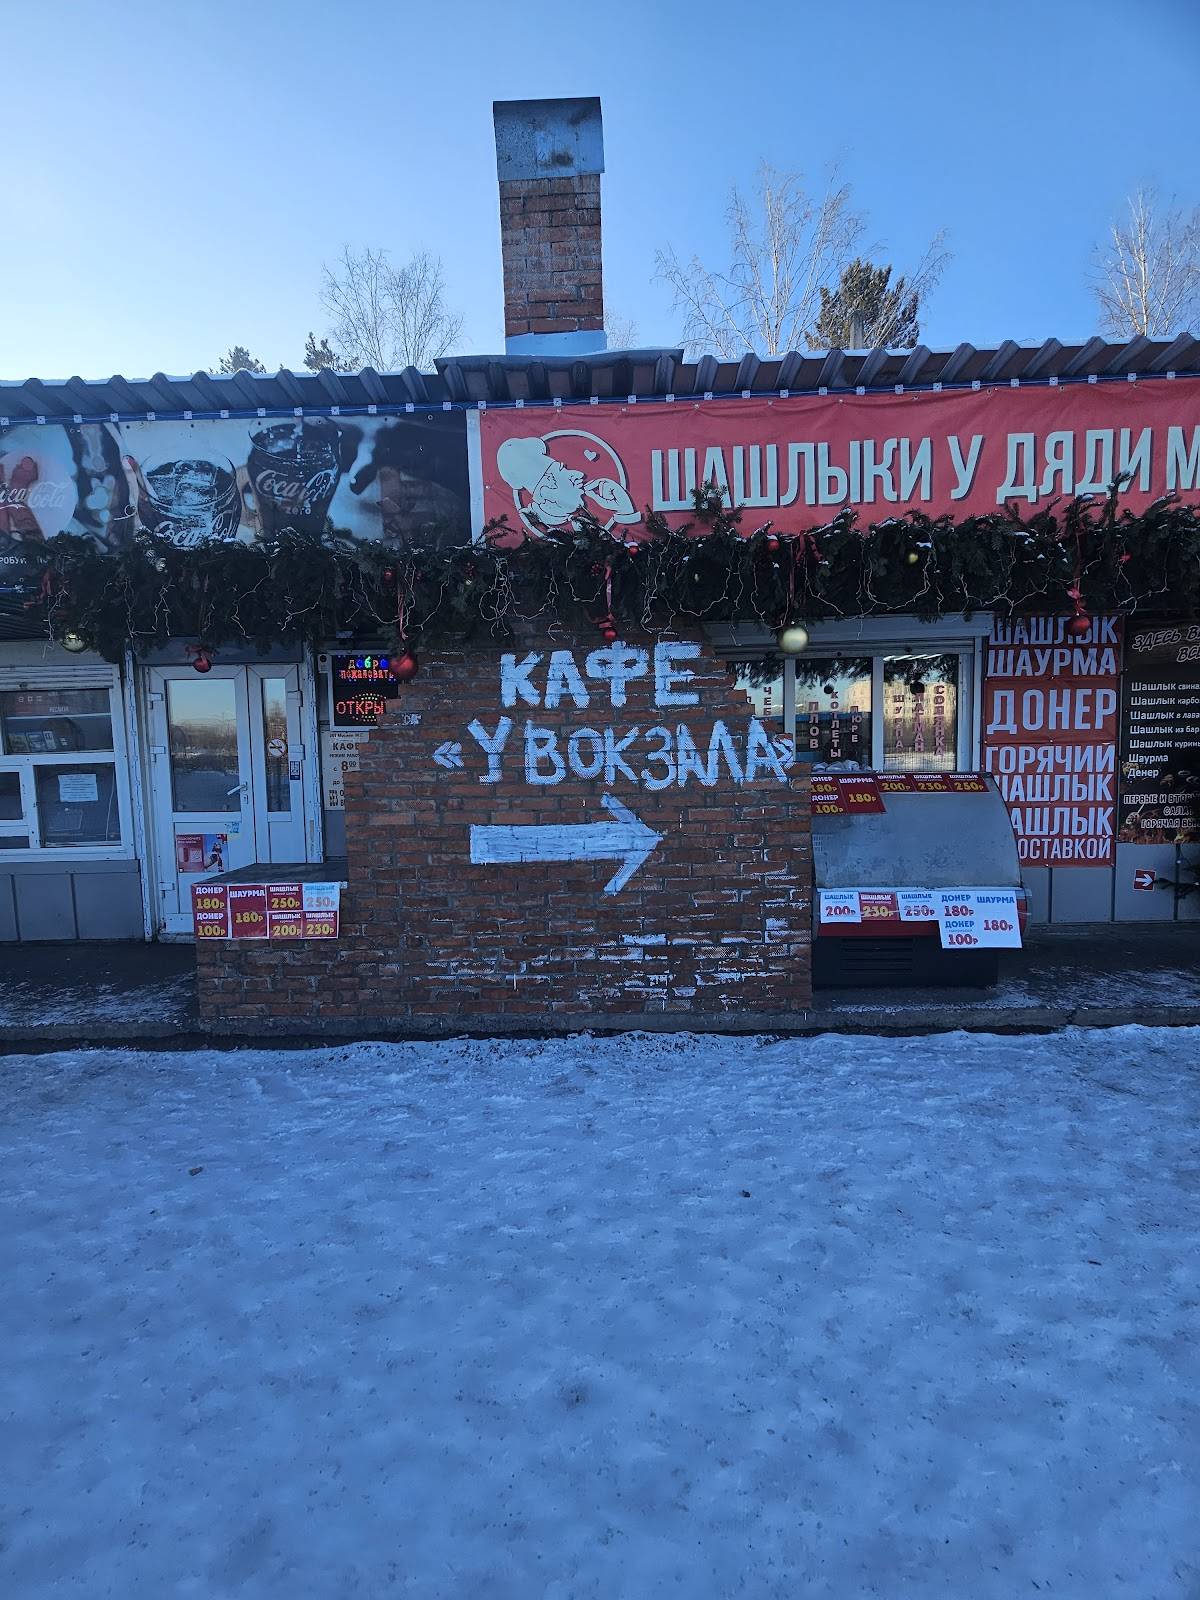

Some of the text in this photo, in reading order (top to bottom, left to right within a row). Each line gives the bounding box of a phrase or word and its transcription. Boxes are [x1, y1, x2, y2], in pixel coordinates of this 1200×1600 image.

[651, 437, 931, 512] ШАШЛЫКИ
[947, 434, 983, 500] У
[996, 427, 1152, 504] ДЯДИ
[1132, 629, 1181, 652] ЗДЕСЬ
[987, 648, 1117, 676] ШАУРМА
[500, 641, 701, 708] КАФЕ
[1131, 682, 1176, 691] Шашлык
[336, 701, 385, 715] ОТКРЫ
[763, 686, 772, 722] ЧЕБ
[1131, 697, 1176, 705] Шашлык
[986, 688, 1117, 734] ДОНЕР
[1130, 711, 1175, 719] Шашлык
[808, 702, 820, 749] ПЛОВ
[830, 691, 841, 758] КОТЛЕТЫ
[851, 705, 862, 743] ПЮРЕ
[1129, 725, 1173, 734] Шашлык
[1129, 740, 1172, 748] Шашлык
[1128, 754, 1169, 765] Шаурма
[1011, 807, 1114, 835] АШЛЫК
[1018, 835, 1111, 859] ОСТАВКОЙ
[196, 887, 224, 895] ДОНЕР
[229, 890, 265, 898] ШАУРМА
[941, 894, 971, 903] ДОНЕР
[976, 896, 1015, 904] ШАУРМА
[945, 920, 975, 929] ДОНЕР
